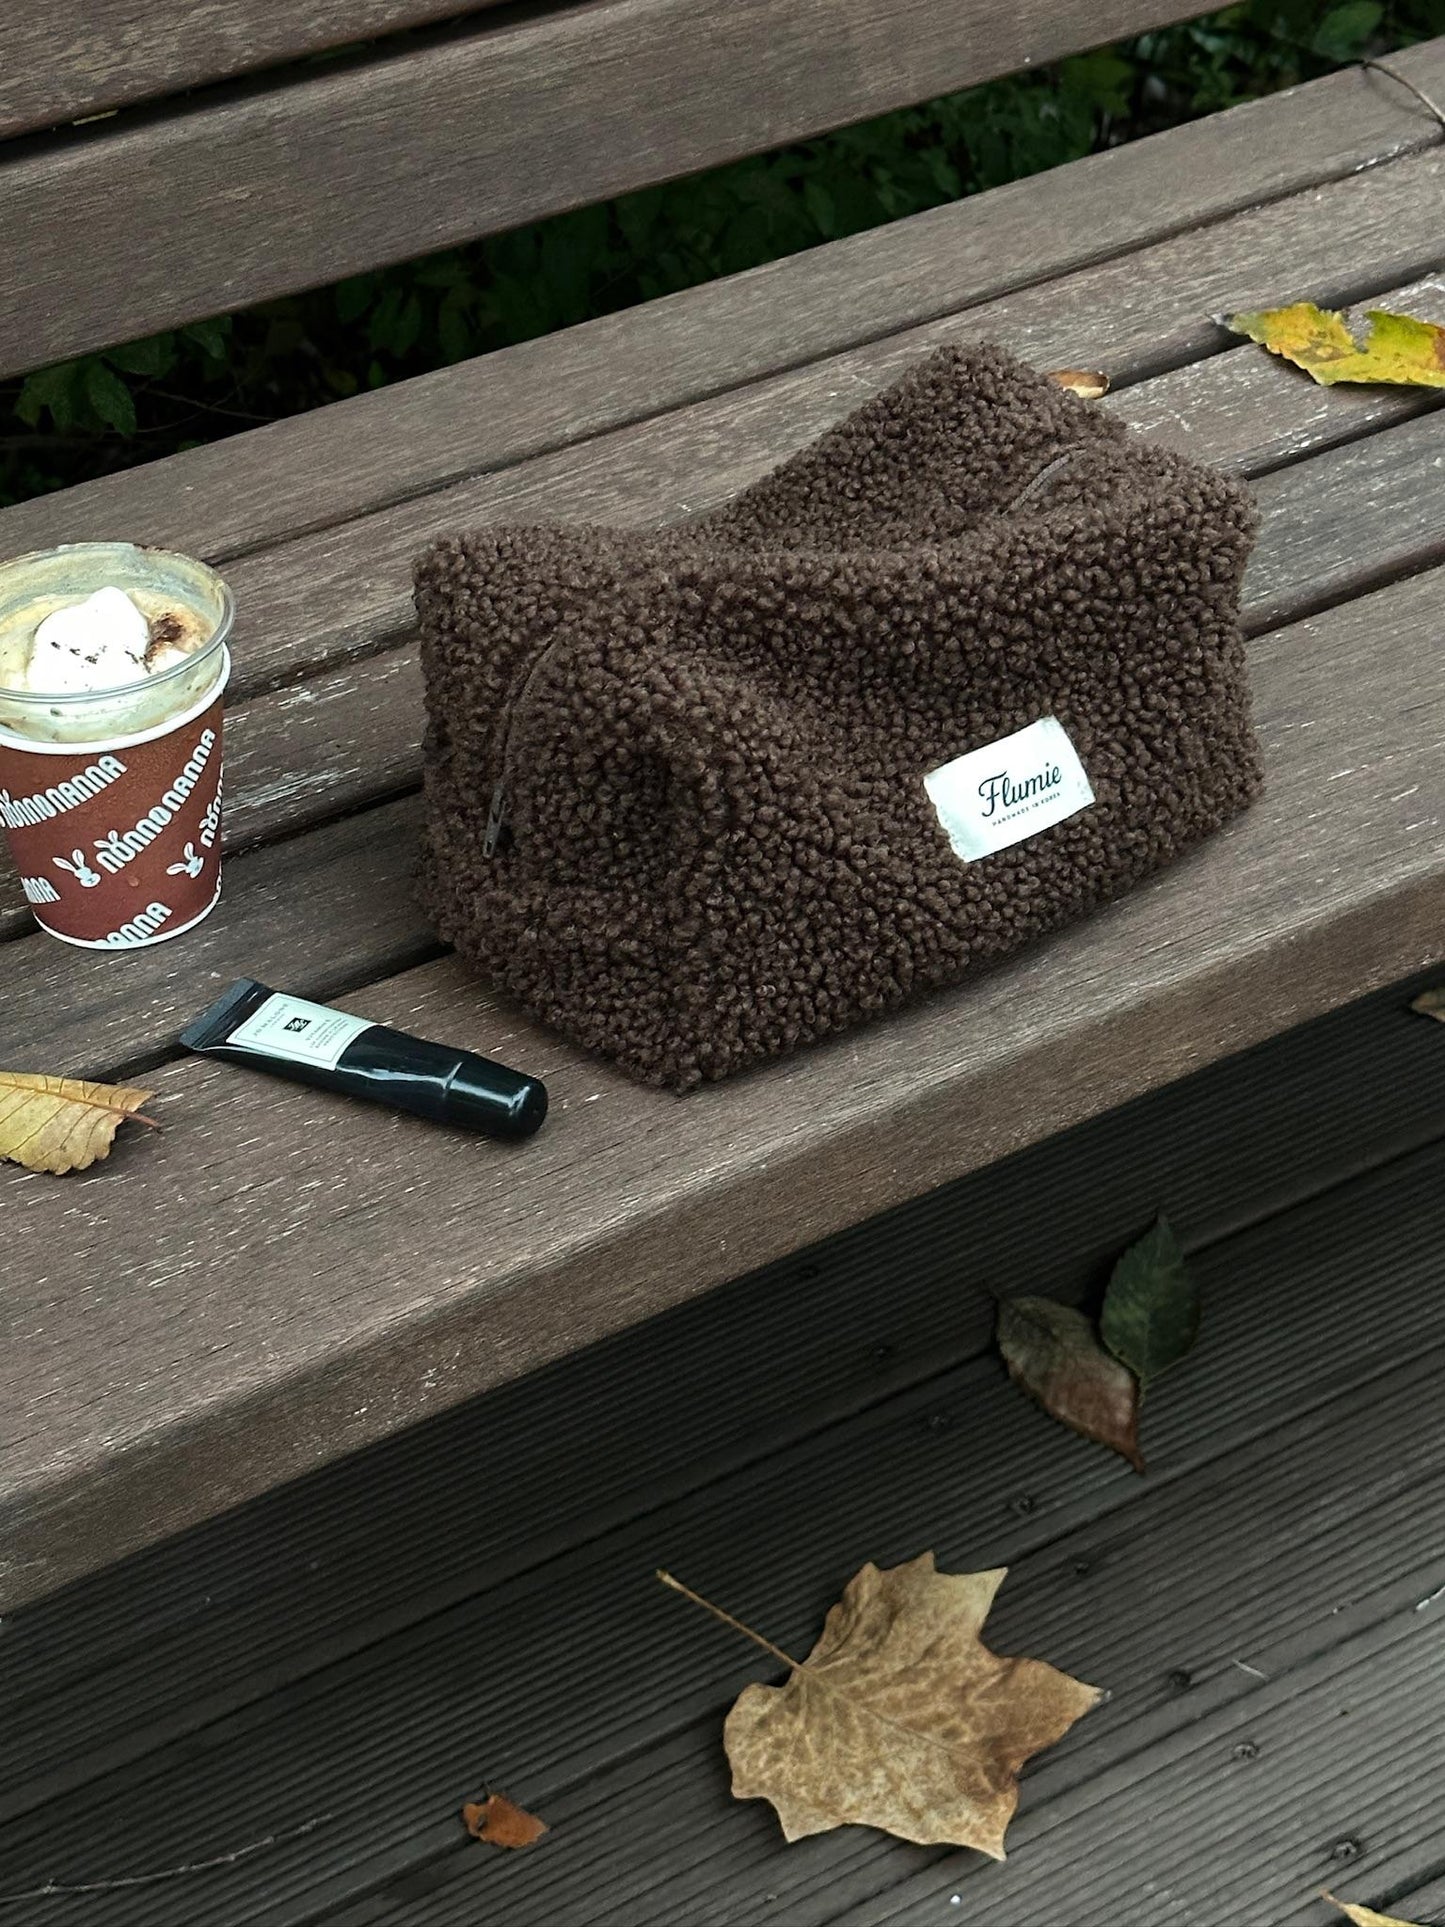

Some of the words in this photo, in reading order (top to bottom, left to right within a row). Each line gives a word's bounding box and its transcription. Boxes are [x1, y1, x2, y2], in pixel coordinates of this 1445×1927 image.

[978, 762, 1062, 818] Flumie
[991, 807, 1030, 827] HANDMADE
[1040, 792, 1061, 805] KOREA
